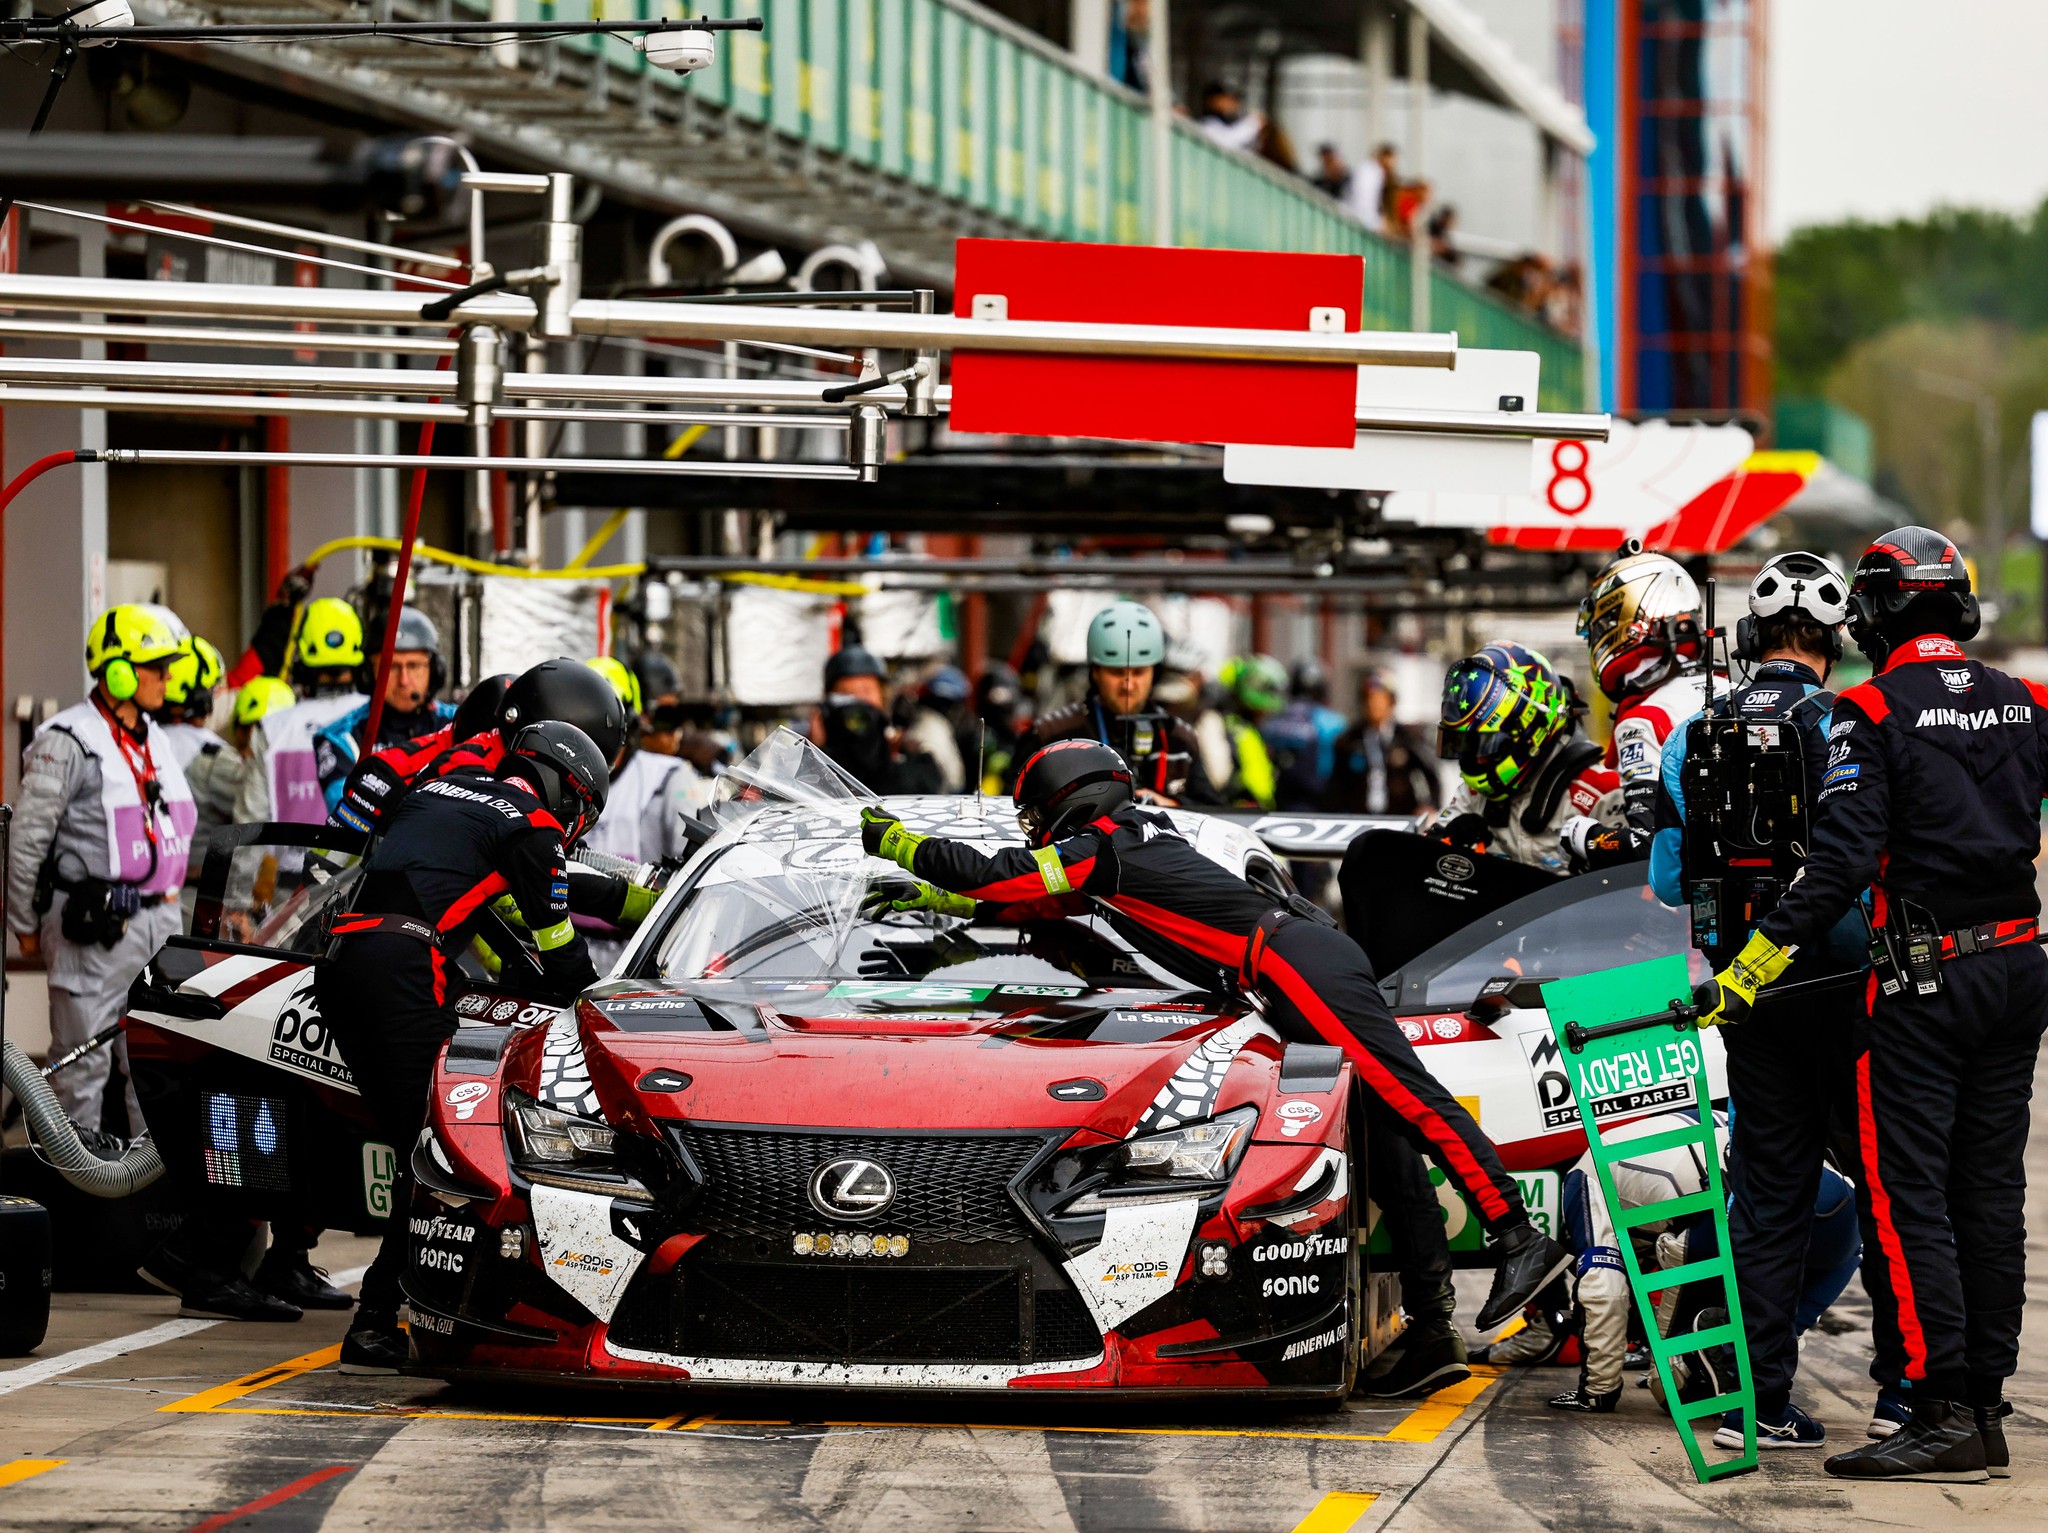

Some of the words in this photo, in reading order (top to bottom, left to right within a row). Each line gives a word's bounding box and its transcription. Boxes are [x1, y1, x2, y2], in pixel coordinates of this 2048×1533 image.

[1547, 439, 1592, 515] 8
[1940, 671, 1972, 686] OMP
[1744, 691, 1781, 705] OMP
[2003, 704, 2032, 723] OIL
[416, 781, 493, 804] MINERVA
[489, 799, 523, 819] OIL
[1573, 790, 1596, 807] OMP
[131, 839, 152, 861] PI
[518, 1007, 556, 1025] OM
[605, 1002, 626, 1012] La
[628, 1000, 686, 1011] Sarthe
[1116, 1012, 1138, 1022] La
[1141, 1013, 1201, 1025] Sarthe
[273, 1046, 324, 1072] SPECIAL
[330, 1065, 354, 1082] PAR
[1656, 1039, 1700, 1082] GET
[1577, 1049, 1654, 1099] READY
[456, 1085, 482, 1098] CSC
[1548, 1099, 1623, 1125] SPEIAL
[1630, 1085, 1688, 1108] PARTS
[1516, 1178, 1544, 1208] M
[408, 1215, 476, 1242] OODYEAR
[1252, 1233, 1348, 1263] GOODYEAR
[558, 1249, 614, 1269] AKKODIS
[565, 1260, 579, 1269] ASP
[580, 1263, 598, 1273] TEAM
[1105, 1261, 1169, 1275] AKKODIS
[1115, 1273, 1130, 1281] ASP
[1132, 1271, 1153, 1280] TEAM
[1262, 1274, 1320, 1298] SONIC
[436, 1317, 455, 1335] OIL
[1281, 1329, 1336, 1362] MINERVA
